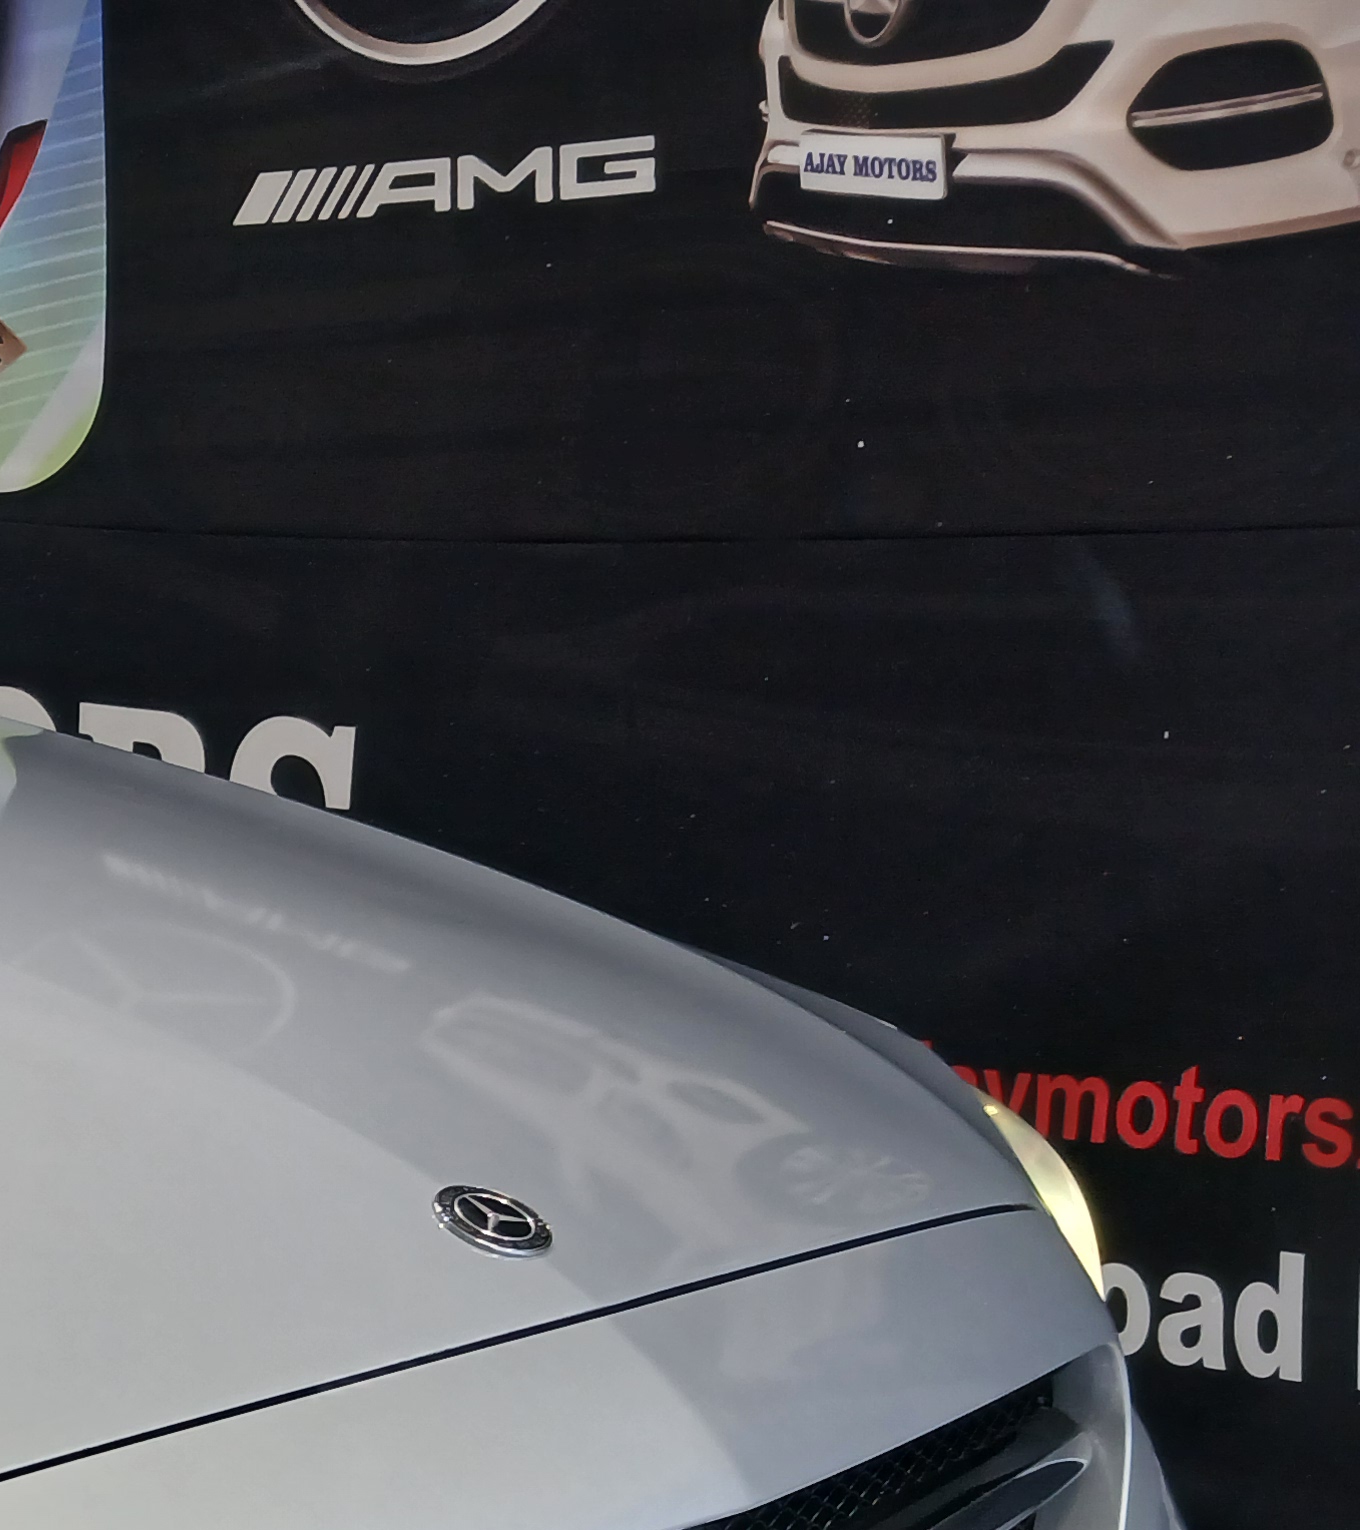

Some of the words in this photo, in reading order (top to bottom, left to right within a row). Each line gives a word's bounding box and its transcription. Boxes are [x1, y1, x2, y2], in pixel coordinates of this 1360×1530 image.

[357, 135, 656, 218] AMG
[803, 150, 848, 177] AJAY
[852, 154, 938, 184] MOTORS
